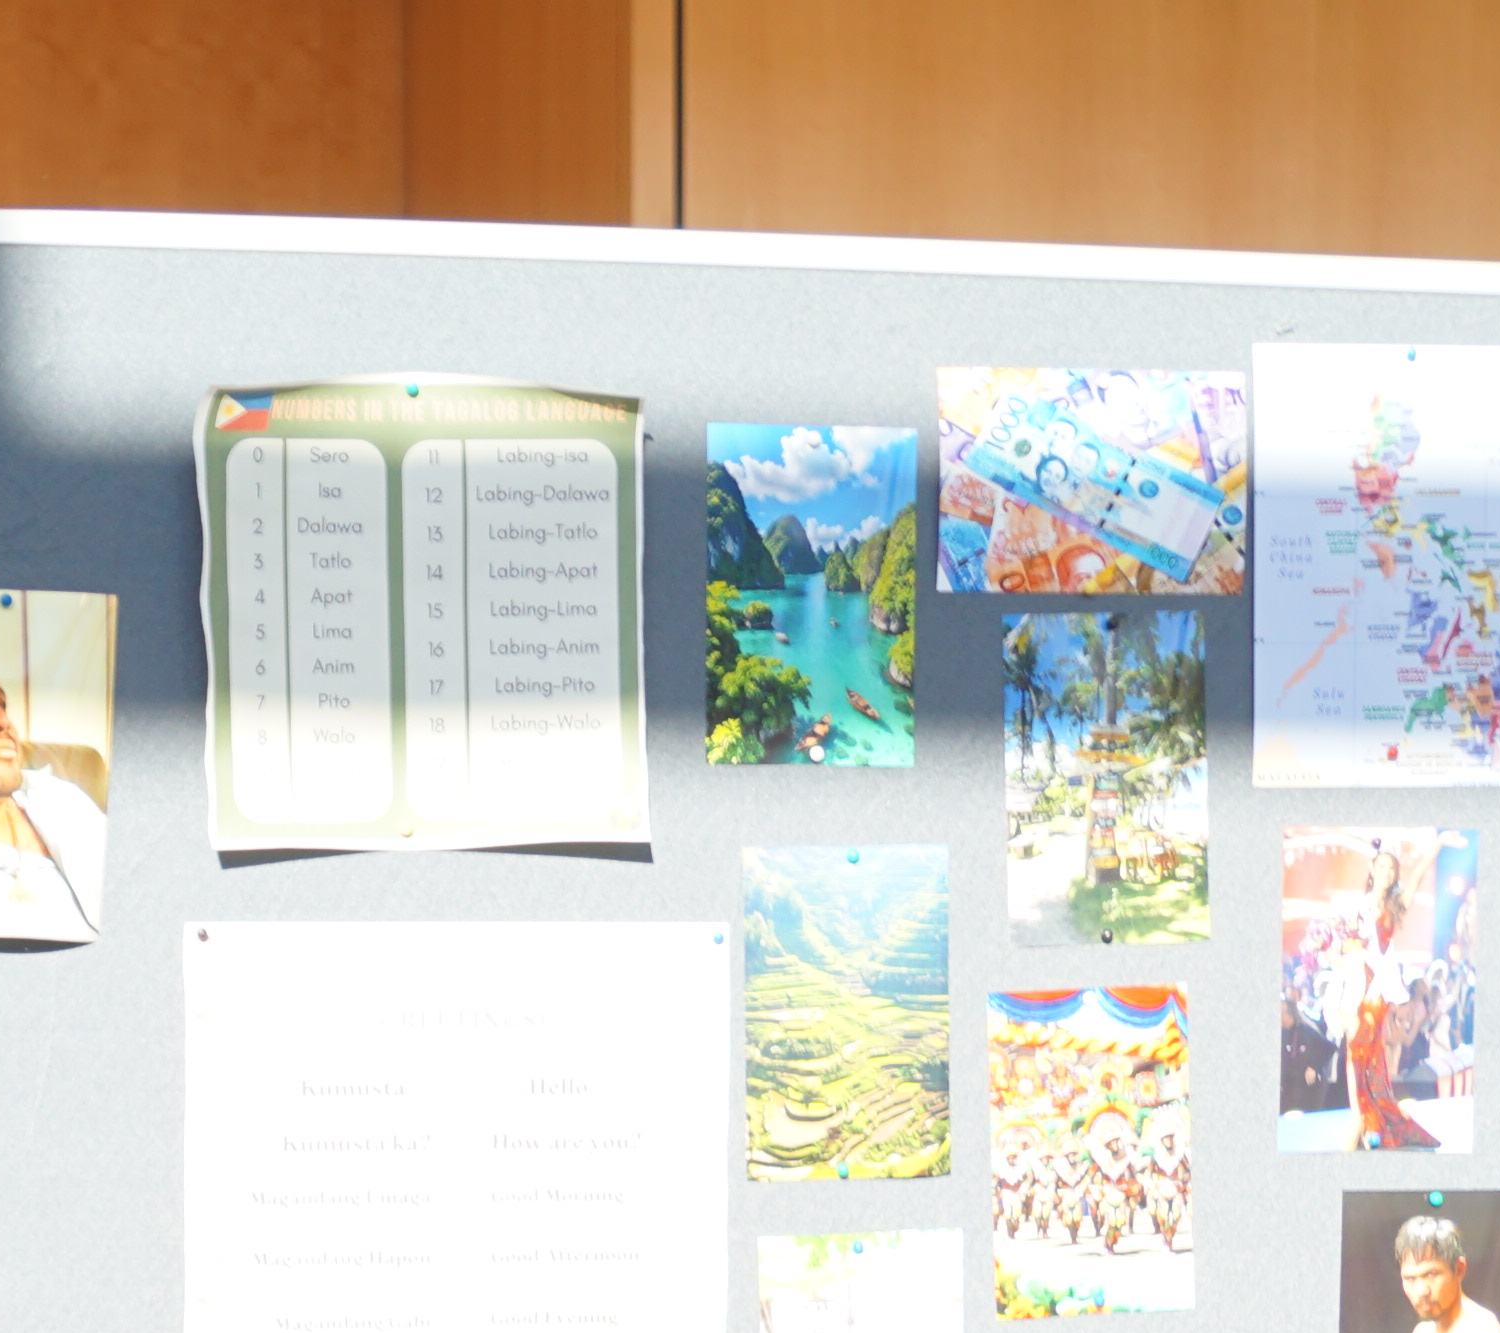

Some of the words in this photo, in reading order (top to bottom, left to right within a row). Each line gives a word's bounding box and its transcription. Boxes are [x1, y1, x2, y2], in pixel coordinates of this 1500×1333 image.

[271, 398, 358, 422] NUMBERS
[363, 399, 384, 422] IN
[388, 399, 424, 423] THE
[431, 399, 518, 423] TAGALOG
[526, 399, 628, 424] LANGUAGE
[252, 449, 263, 464] 0
[309, 449, 349, 464] Sero
[496, 448, 589, 468] Labing-isa
[255, 483, 262, 500] 1
[317, 483, 342, 499] Isa
[425, 487, 443, 504] 12
[476, 485, 611, 505] Labing-Dalawa
[252, 518, 264, 535] 2
[297, 518, 363, 536] Dalawa
[427, 526, 444, 543] 13
[488, 524, 599, 544] Labing-Tatlo
[253, 553, 264, 570] 3
[310, 553, 352, 570] Tatlo
[426, 565, 444, 582] 14
[488, 563, 599, 583] Labing-Apat
[254, 589, 266, 604] 4
[310, 588, 353, 609] Apat
[428, 603, 444, 620] 15
[489, 601, 598, 621] Labing-Lima
[255, 624, 266, 641] 5
[312, 623, 352, 640] Lima
[428, 641, 445, 658] 16
[489, 638, 600, 659] Labing-Anim
[255, 659, 266, 675] 6
[312, 658, 355, 675] Anim
[429, 679, 445, 696] 17
[495, 677, 596, 697] Labing-Pito
[256, 694, 266, 710] 7
[318, 693, 351, 710] Pito
[490, 715, 602, 735] Labing-Walo
[301, 1079, 407, 1098] Kumusta
[529, 1078, 589, 1097] Hello
[491, 1133, 541, 1151] How
